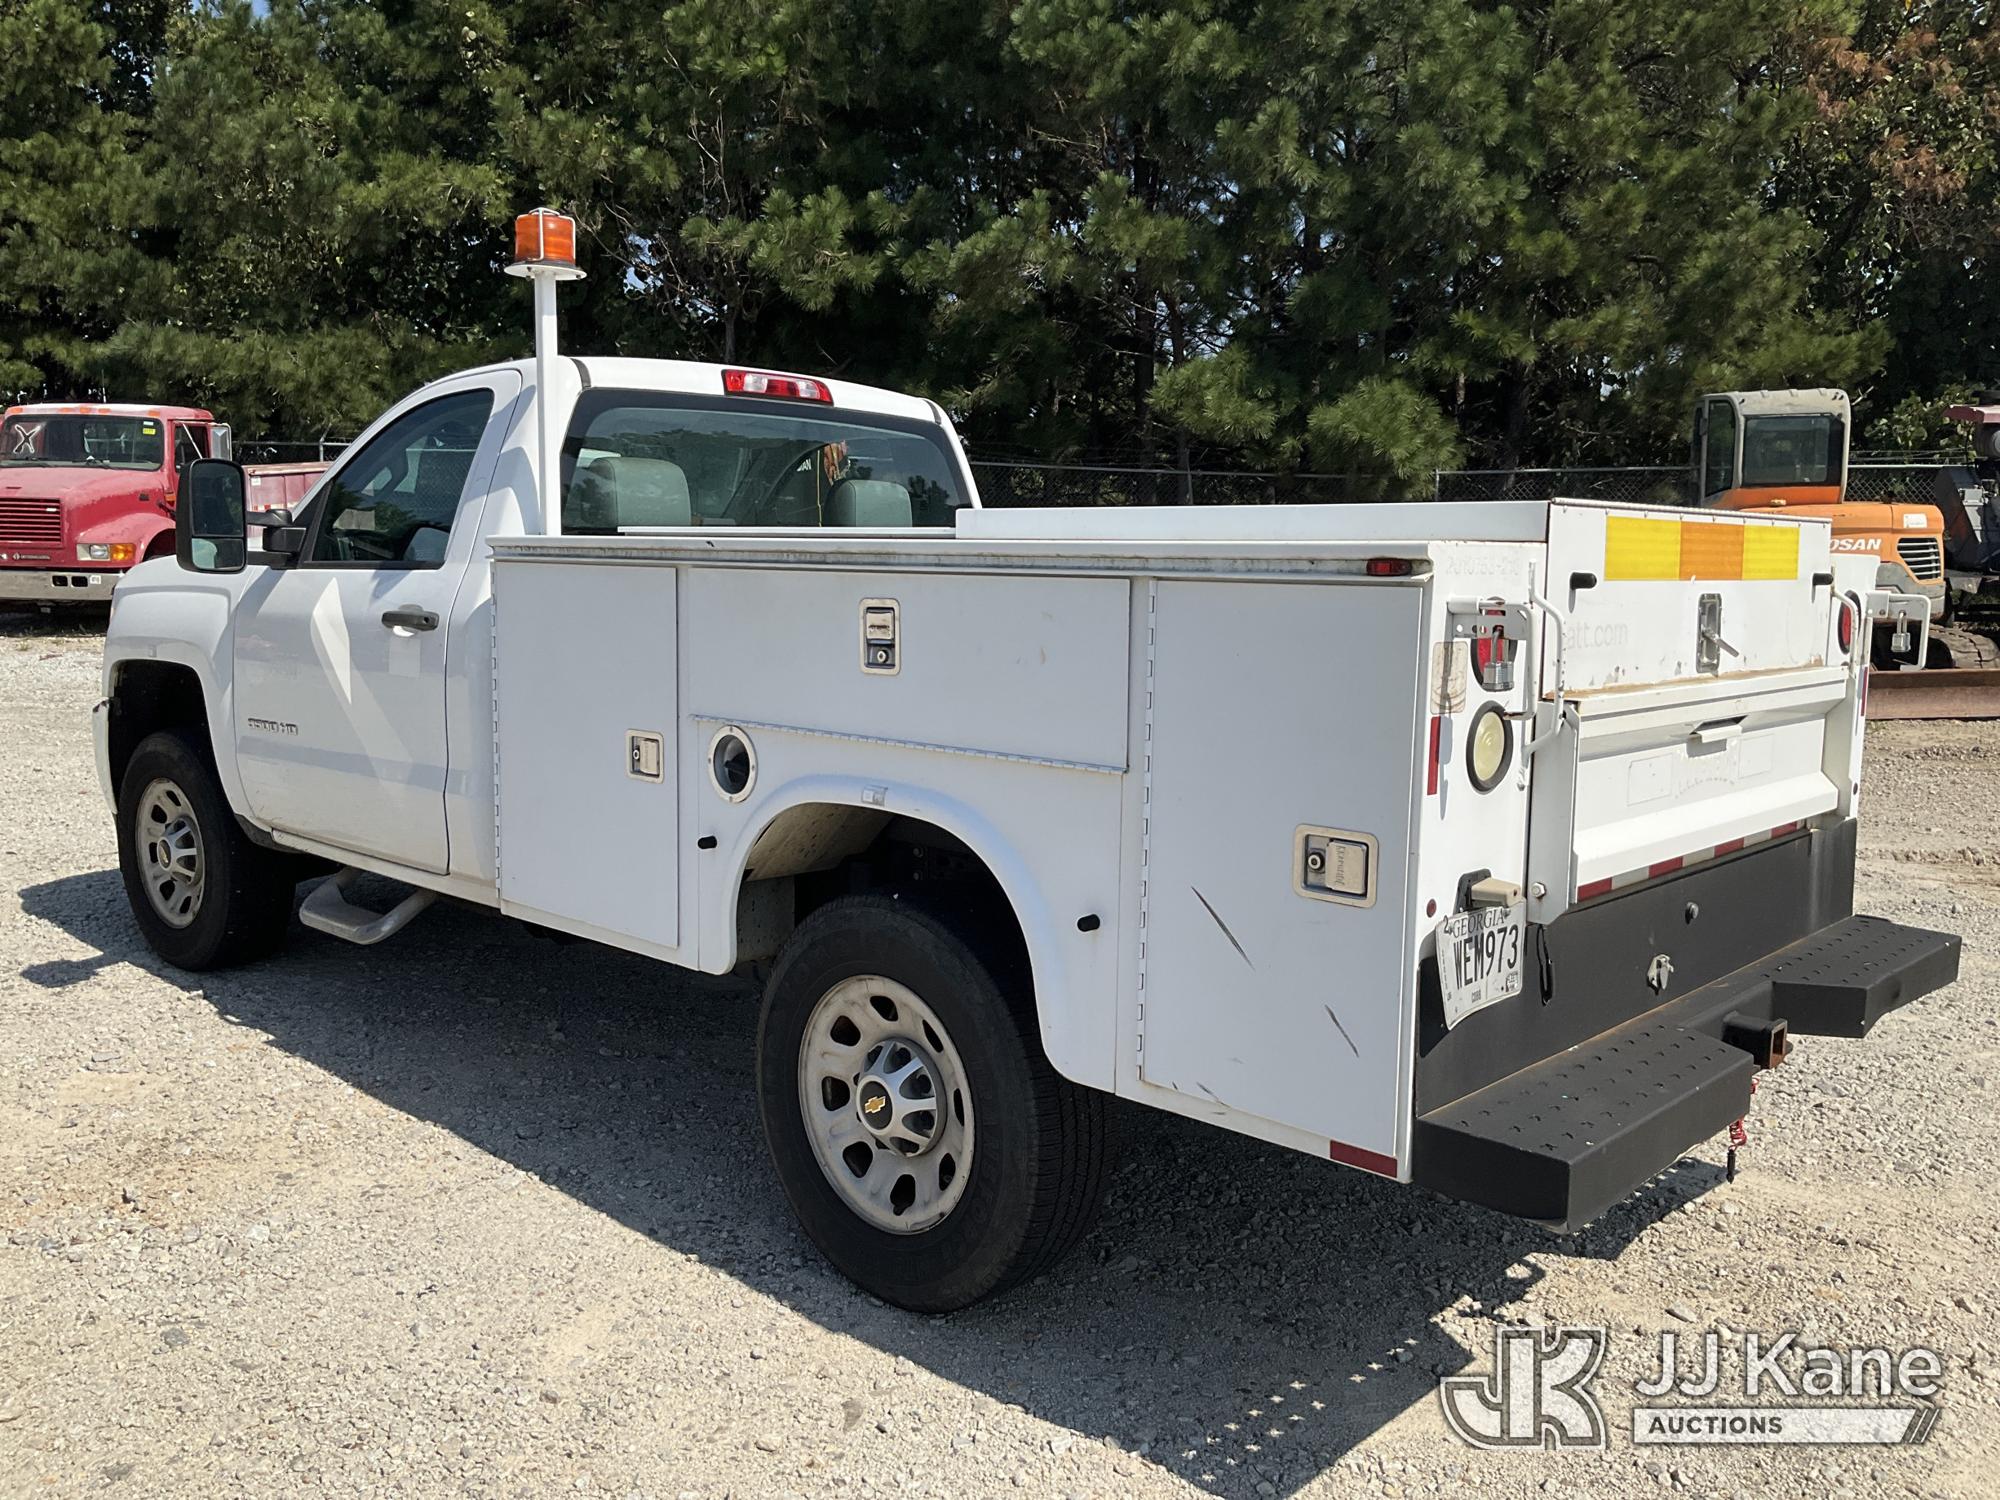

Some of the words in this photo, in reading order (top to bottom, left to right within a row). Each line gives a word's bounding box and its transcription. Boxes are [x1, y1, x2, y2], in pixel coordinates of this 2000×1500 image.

[1567, 622, 1629, 649] att.com
[1452, 908, 1505, 938] GEORGIA
[1453, 924, 1519, 990] WEM973
